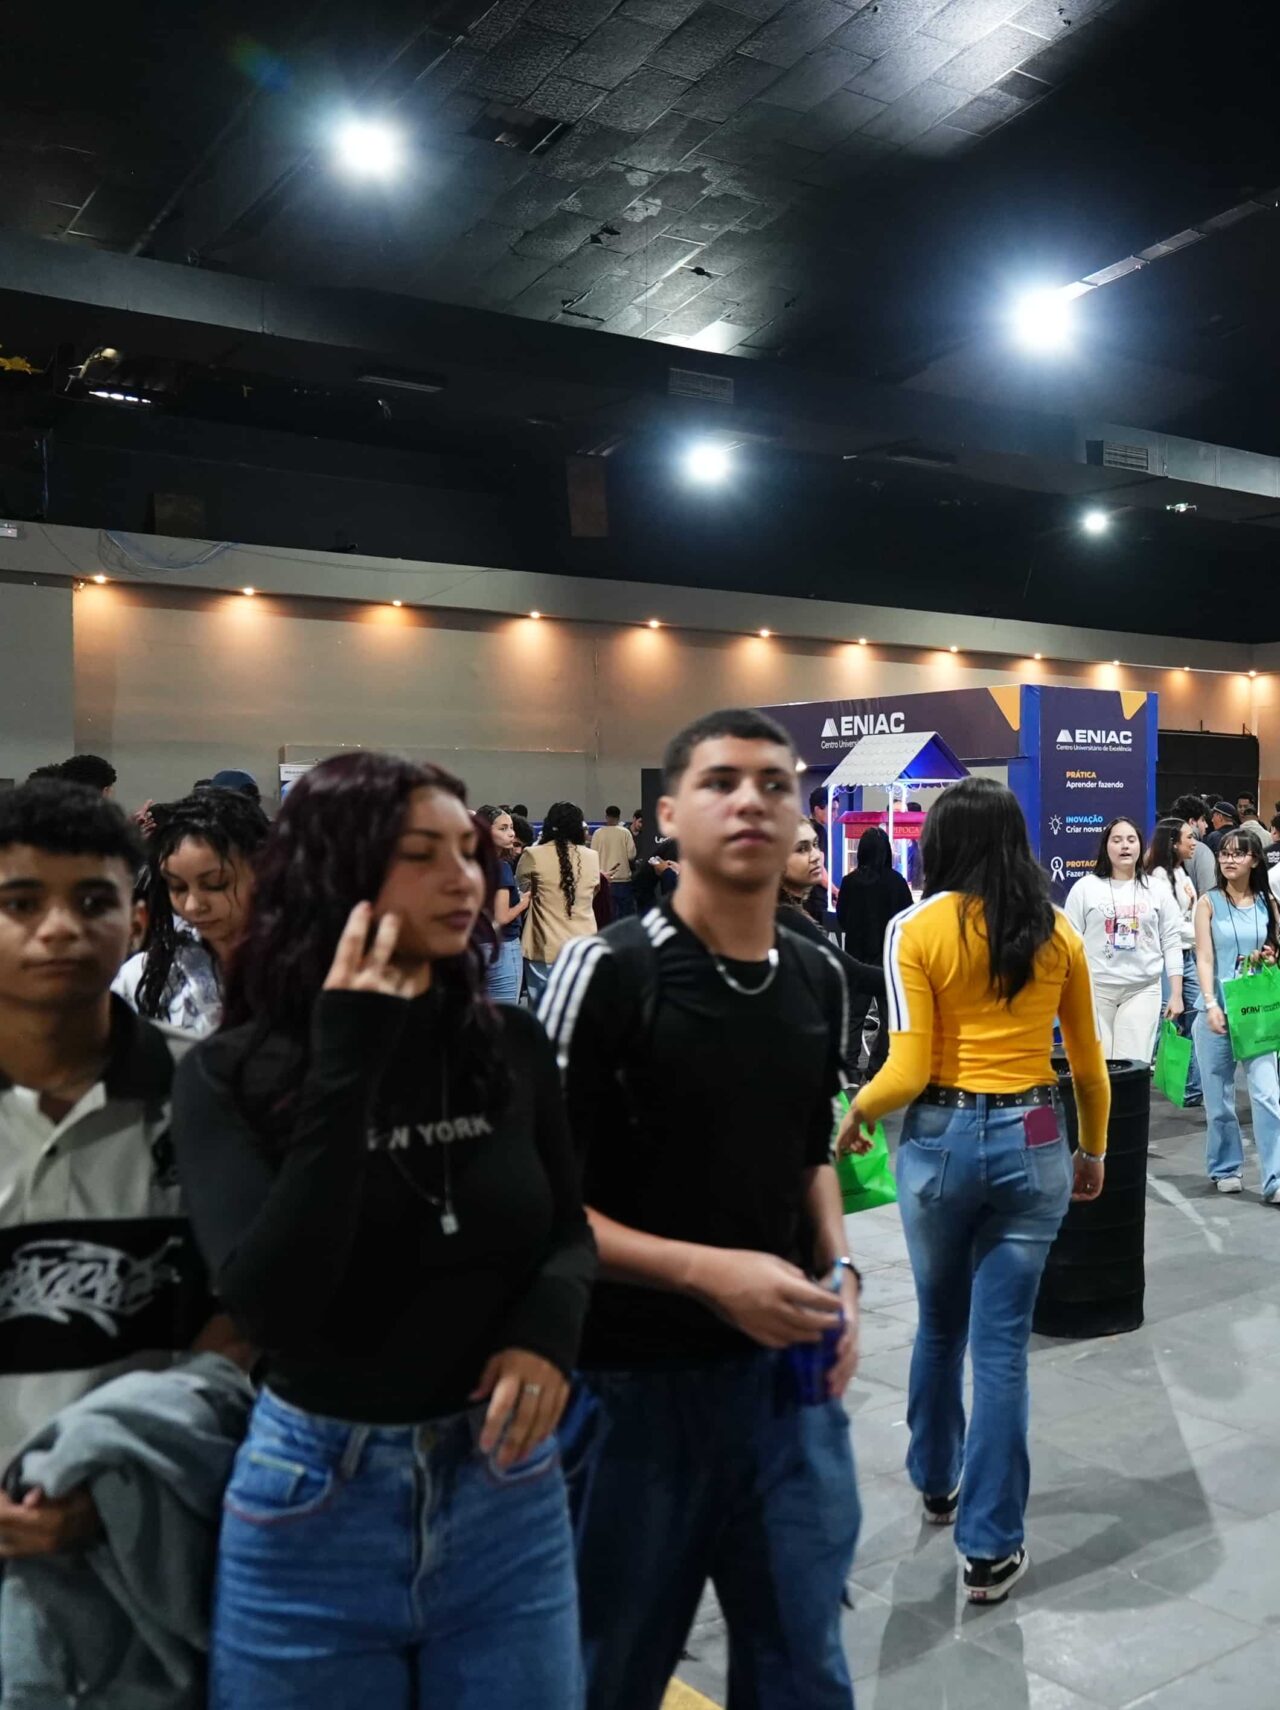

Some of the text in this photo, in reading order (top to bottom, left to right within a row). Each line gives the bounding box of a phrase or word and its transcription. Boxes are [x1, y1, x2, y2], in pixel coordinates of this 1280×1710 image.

[841, 712, 905, 736] ENIAC
[1075, 729, 1133, 744] ENIAC
[821, 741, 838, 749] Centro
[1066, 769, 1097, 778] PRÁTICA
[1066, 781, 1097, 790] Aprender
[1066, 814, 1103, 825] INOVAÇÃO
[1066, 860, 1097, 868] PROTAG
[416, 1116, 493, 1146] YORK
